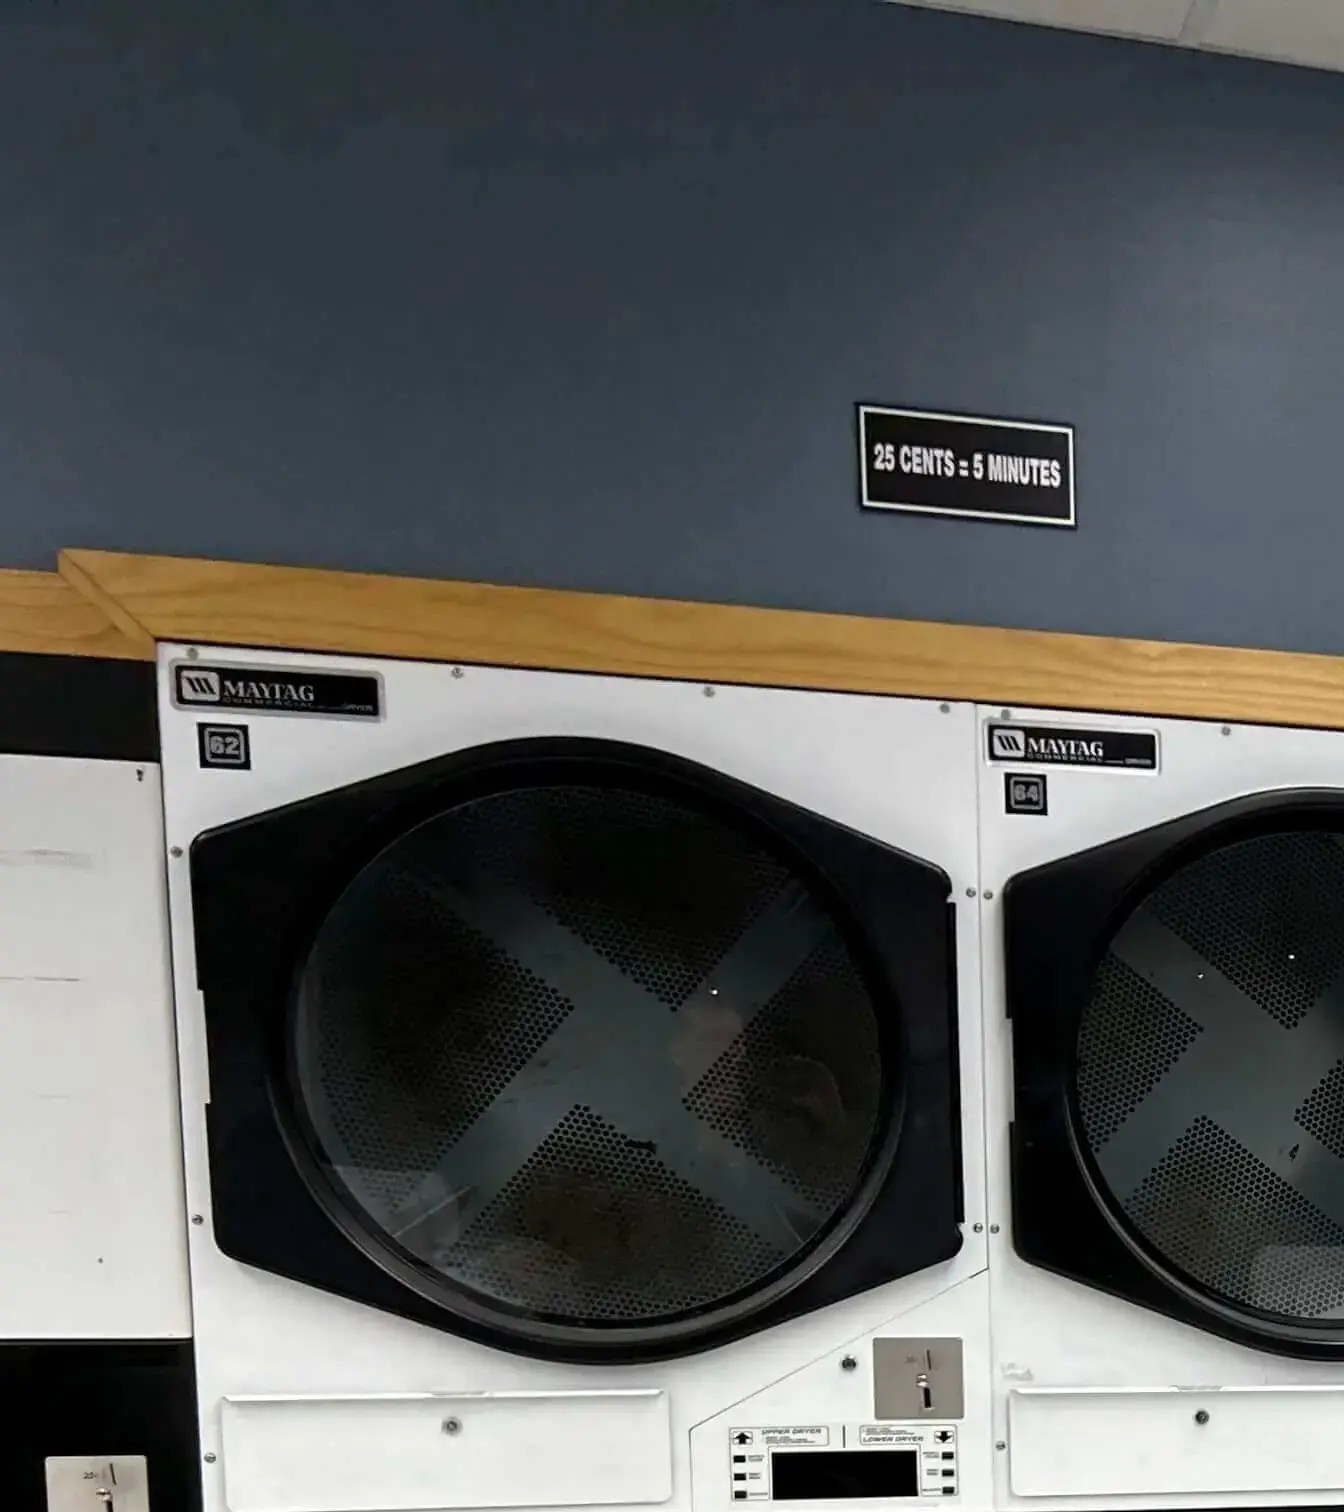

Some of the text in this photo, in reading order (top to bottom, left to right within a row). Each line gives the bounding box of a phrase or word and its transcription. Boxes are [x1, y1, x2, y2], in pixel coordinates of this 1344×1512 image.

[874, 443, 1061, 488] 25 CENTS = 5 MINUTES
[223, 680, 314, 701] MAYTAG
[210, 735, 240, 756] 62
[1028, 738, 1104, 757] MAYTAG
[1014, 784, 1039, 801] 64
